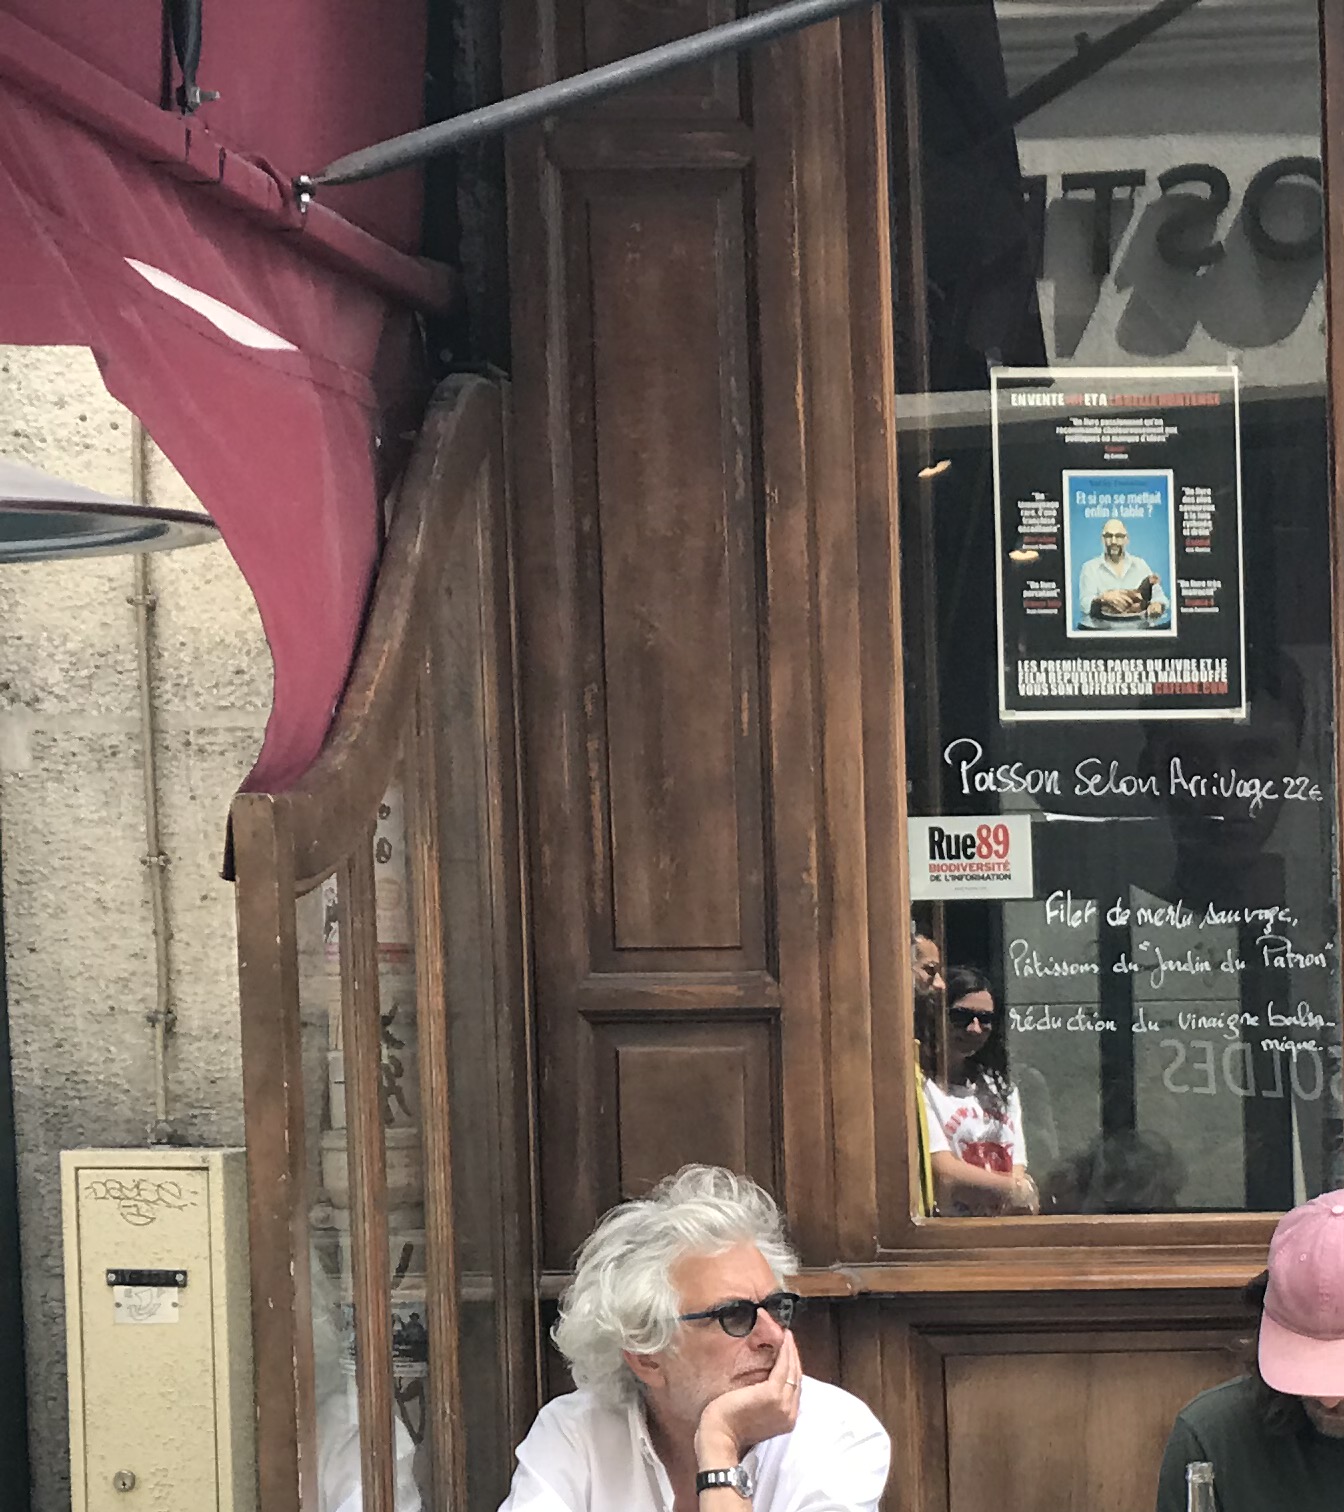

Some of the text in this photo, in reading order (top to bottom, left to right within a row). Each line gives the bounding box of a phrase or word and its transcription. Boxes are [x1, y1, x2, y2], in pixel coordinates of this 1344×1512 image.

[928, 824, 1010, 860] Rue89
[928, 861, 1010, 873] BIODIVERSITÉ
[929, 873, 1012, 882] DE L'INFORMATION
[1045, 890, 1099, 928] Filet
[1106, 897, 1129, 927] de
[1112, 952, 1139, 975] du
[1220, 949, 1246, 972] du
[1131, 1007, 1160, 1033] du
